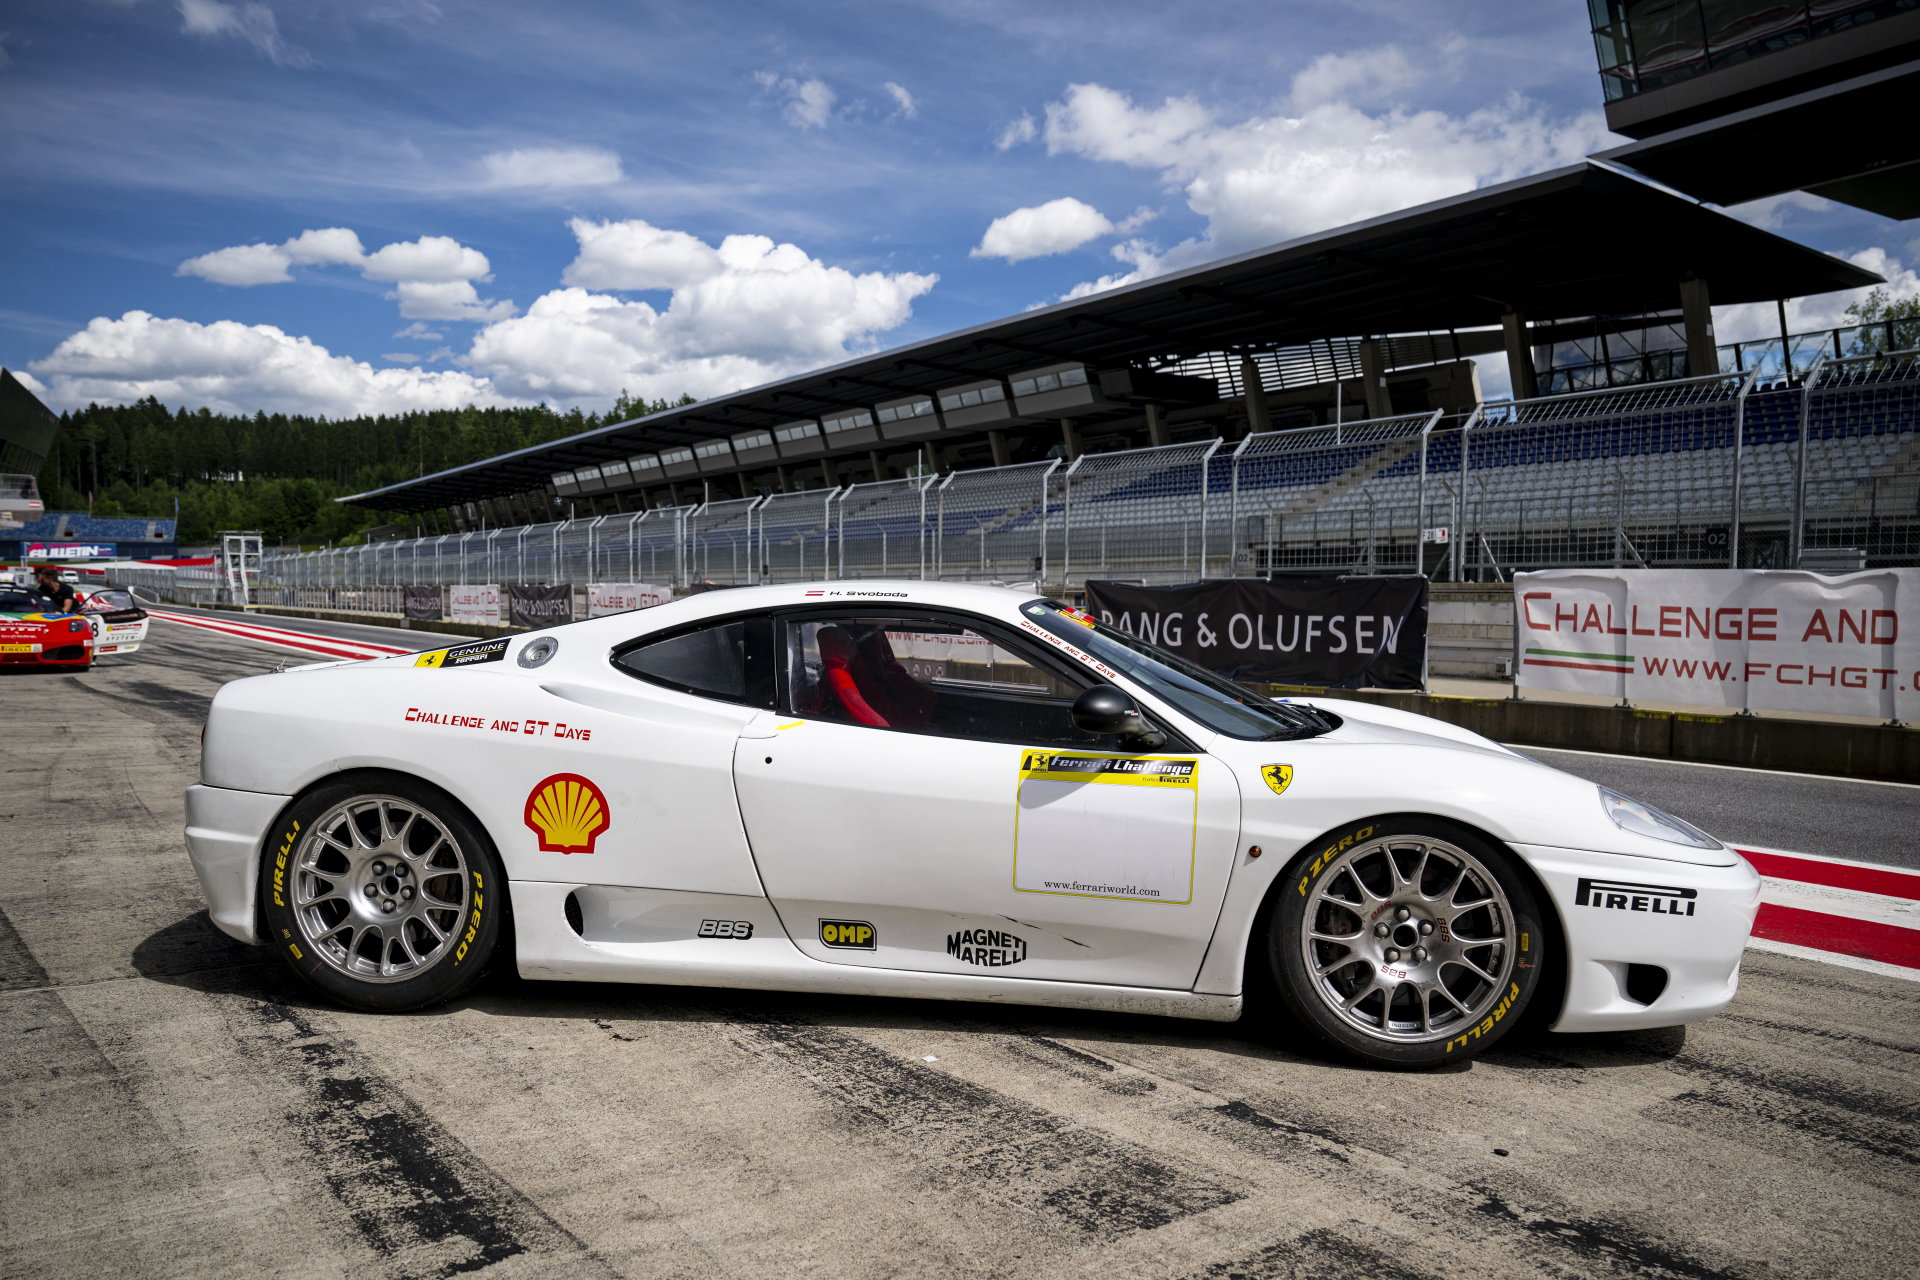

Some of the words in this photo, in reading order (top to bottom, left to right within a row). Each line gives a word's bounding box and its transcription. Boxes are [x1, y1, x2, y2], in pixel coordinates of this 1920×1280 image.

[1708, 533, 1727, 545] 02
[1237, 553, 1248, 562] 02
[1523, 592, 1777, 641] CHALLENGE
[1802, 608, 1898, 645] AND
[1197, 612, 1218, 648] &
[1228, 612, 1404, 655] OLUFSEN
[449, 642, 506, 657] GENUINE
[455, 653, 488, 664] Ferrari
[1021, 620, 1063, 647] CHALLENGE
[1064, 645, 1080, 656] AND
[1080, 654, 1096, 664] GT
[1096, 663, 1117, 679] DAYS
[1642, 656, 1920, 692] WWW.FCHGT.
[405, 707, 485, 729] CHALLENGE
[491, 719, 519, 732] AND
[524, 719, 549, 736] GT
[554, 722, 592, 741] DAYS
[1050, 755, 1112, 771] Ferrari
[1113, 759, 1192, 776] Challenge
[272, 820, 300, 907] PIRELLI
[1310, 825, 1373, 880] ZERO
[1044, 881, 1161, 897] www.ferrariworld.com
[1575, 877, 1698, 917] PIRELLI
[456, 892, 484, 962] ZERO
[698, 919, 753, 940] BBS
[823, 924, 873, 944] OMP
[1437, 918, 1450, 943] BBS
[947, 929, 1027, 955] MAGNETI
[947, 942, 1027, 967] MARELLI
[1446, 982, 1520, 1053] PIRELLI
